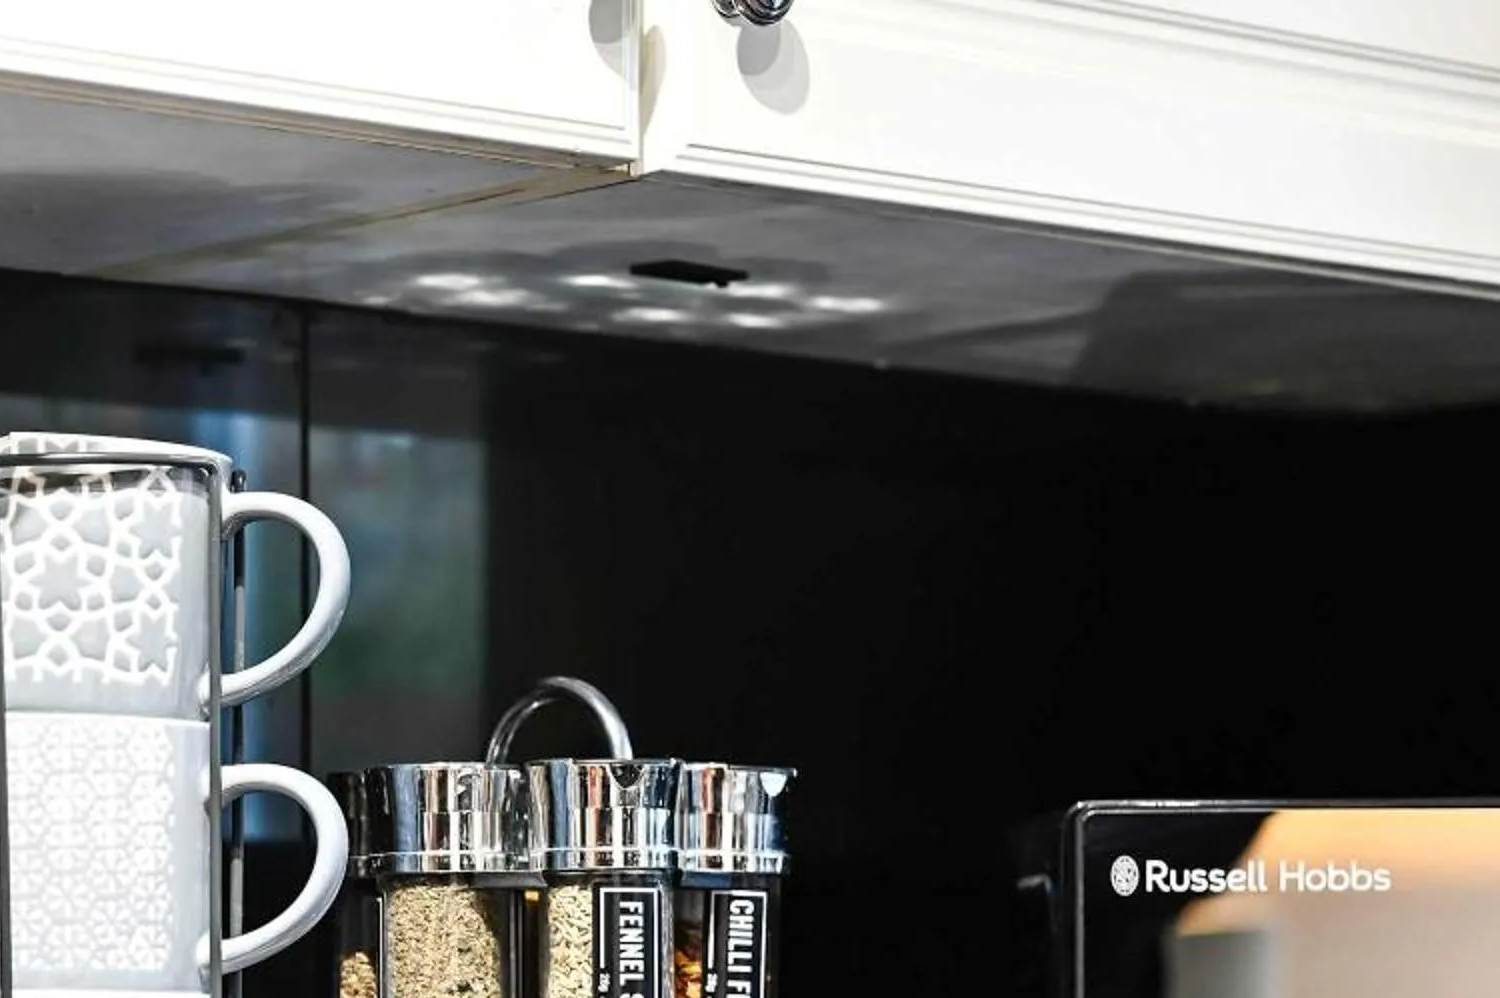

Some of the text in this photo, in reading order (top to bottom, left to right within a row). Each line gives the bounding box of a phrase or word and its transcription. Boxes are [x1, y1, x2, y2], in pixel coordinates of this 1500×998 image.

[1145, 859, 1392, 893] Russell Hobbs
[619, 901, 644, 986] FENNEL
[728, 899, 755, 974] CHILLI
